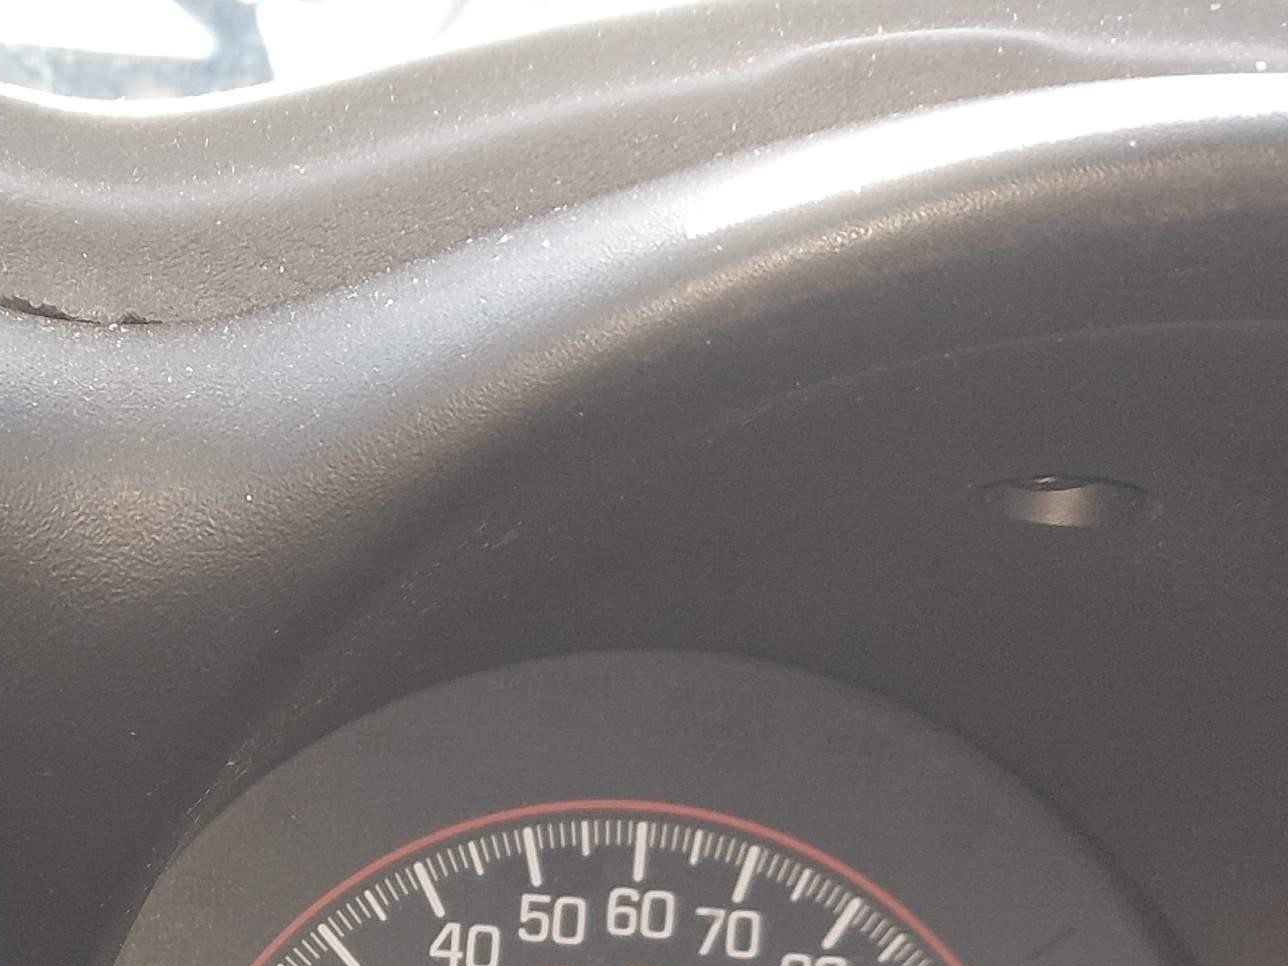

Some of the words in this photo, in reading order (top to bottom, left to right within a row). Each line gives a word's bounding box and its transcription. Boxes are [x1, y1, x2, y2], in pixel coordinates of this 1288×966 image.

[519, 894, 585, 944] 50
[608, 888, 674, 938] 60
[696, 908, 760, 958] 70
